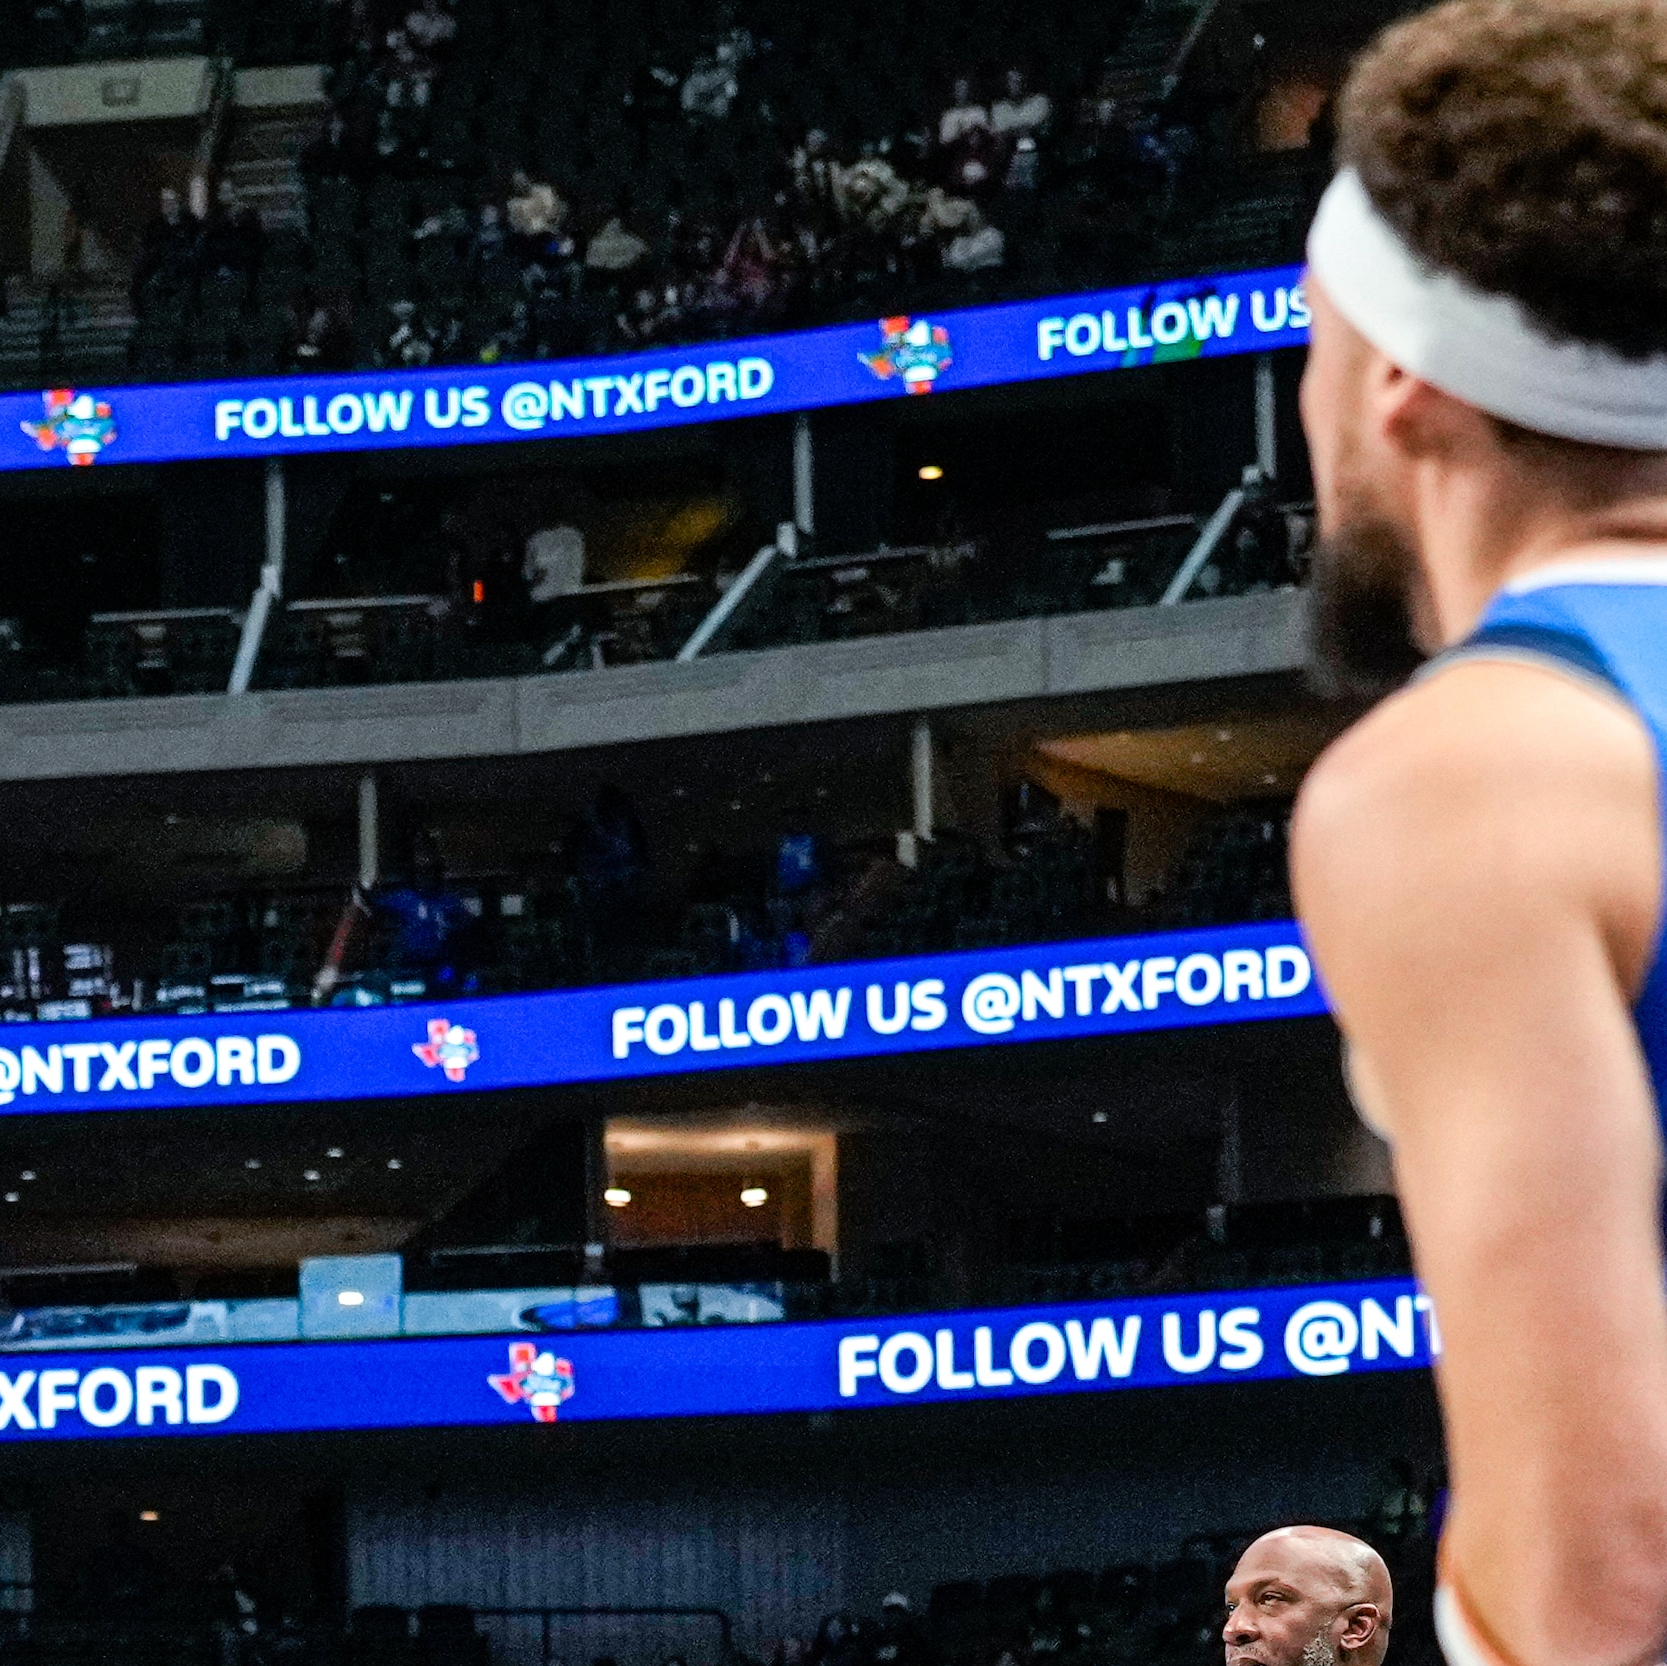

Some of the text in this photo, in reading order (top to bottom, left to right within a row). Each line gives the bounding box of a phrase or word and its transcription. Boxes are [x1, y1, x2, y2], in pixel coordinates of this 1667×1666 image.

[1038, 287, 1312, 360] FOLLOW US
[216, 360, 772, 440] FOLLOW US @NTXFORD
[613, 946, 1312, 1058] FOLLOW US @NTXFORD
[839, 1316, 1141, 1396] FOLLOW
[1163, 1308, 1263, 1372] US
